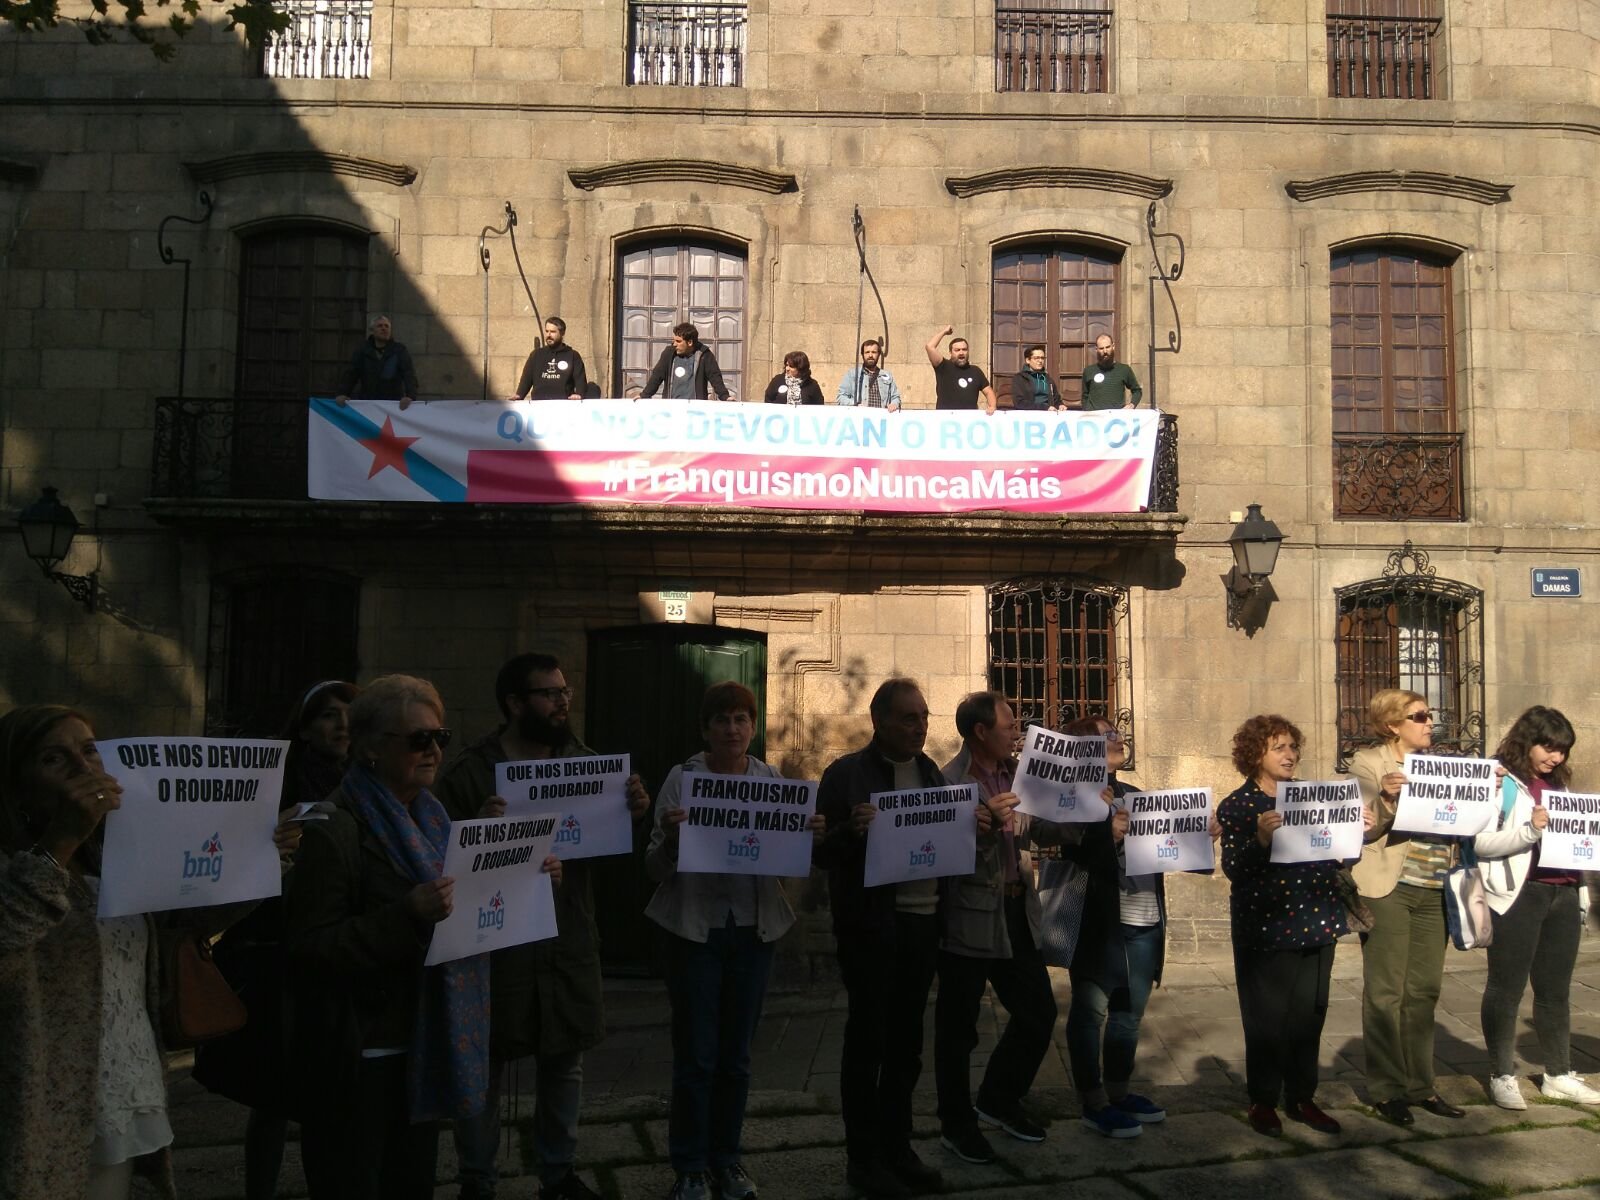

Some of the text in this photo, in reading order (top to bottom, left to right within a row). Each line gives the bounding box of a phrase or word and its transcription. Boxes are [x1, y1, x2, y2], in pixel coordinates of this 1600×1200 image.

[686, 409, 888, 448] DEVOLVAN
[900, 418, 926, 449] O
[940, 417, 1140, 450] ROUBADO!
[600, 458, 1062, 502] #FranquismoNuncaMáis
[1542, 583, 1571, 593] DAMAS
[667, 604, 683, 616] 25
[117, 744, 282, 769] QUE NOS DEVOLVAN
[1033, 732, 1106, 760] FRANQUISMO
[506, 759, 623, 782] QUE NOS DEVOLVAN
[1026, 757, 1105, 784] NUNCA MÁIS!
[1411, 759, 1491, 779] FRANQUISMO
[158, 778, 259, 803] O ROUBADO!
[529, 780, 604, 800] O ROUBADO!
[692, 778, 809, 805] FRANQUISMO
[878, 788, 972, 811] QUE NOS DEVOLVAN
[1285, 783, 1359, 803] FRANQUISMO
[1408, 781, 1490, 802] NUNCA MÁIS!
[1058, 793, 1076, 810] bng
[1131, 792, 1207, 815] FRANQUISMO
[688, 806, 806, 832] NUNCA MÁIS!
[894, 808, 956, 828] O ROUBADO!
[1129, 815, 1207, 836] NUNCA MÁIS!
[1282, 805, 1361, 826] NUNCA MÁIS!
[1434, 808, 1458, 825] bng
[459, 818, 556, 849] QUE NOS DEVOLVAN
[1547, 817, 1600, 836] NUNCA M
[728, 840, 760, 861] bng
[1310, 834, 1332, 849] bng
[1572, 843, 1593, 859] bng
[472, 845, 534, 872] O ROUBADO!
[909, 851, 936, 867] bng
[1157, 845, 1179, 860] bng
[182, 851, 223, 882] bng
[477, 907, 504, 930] bng
